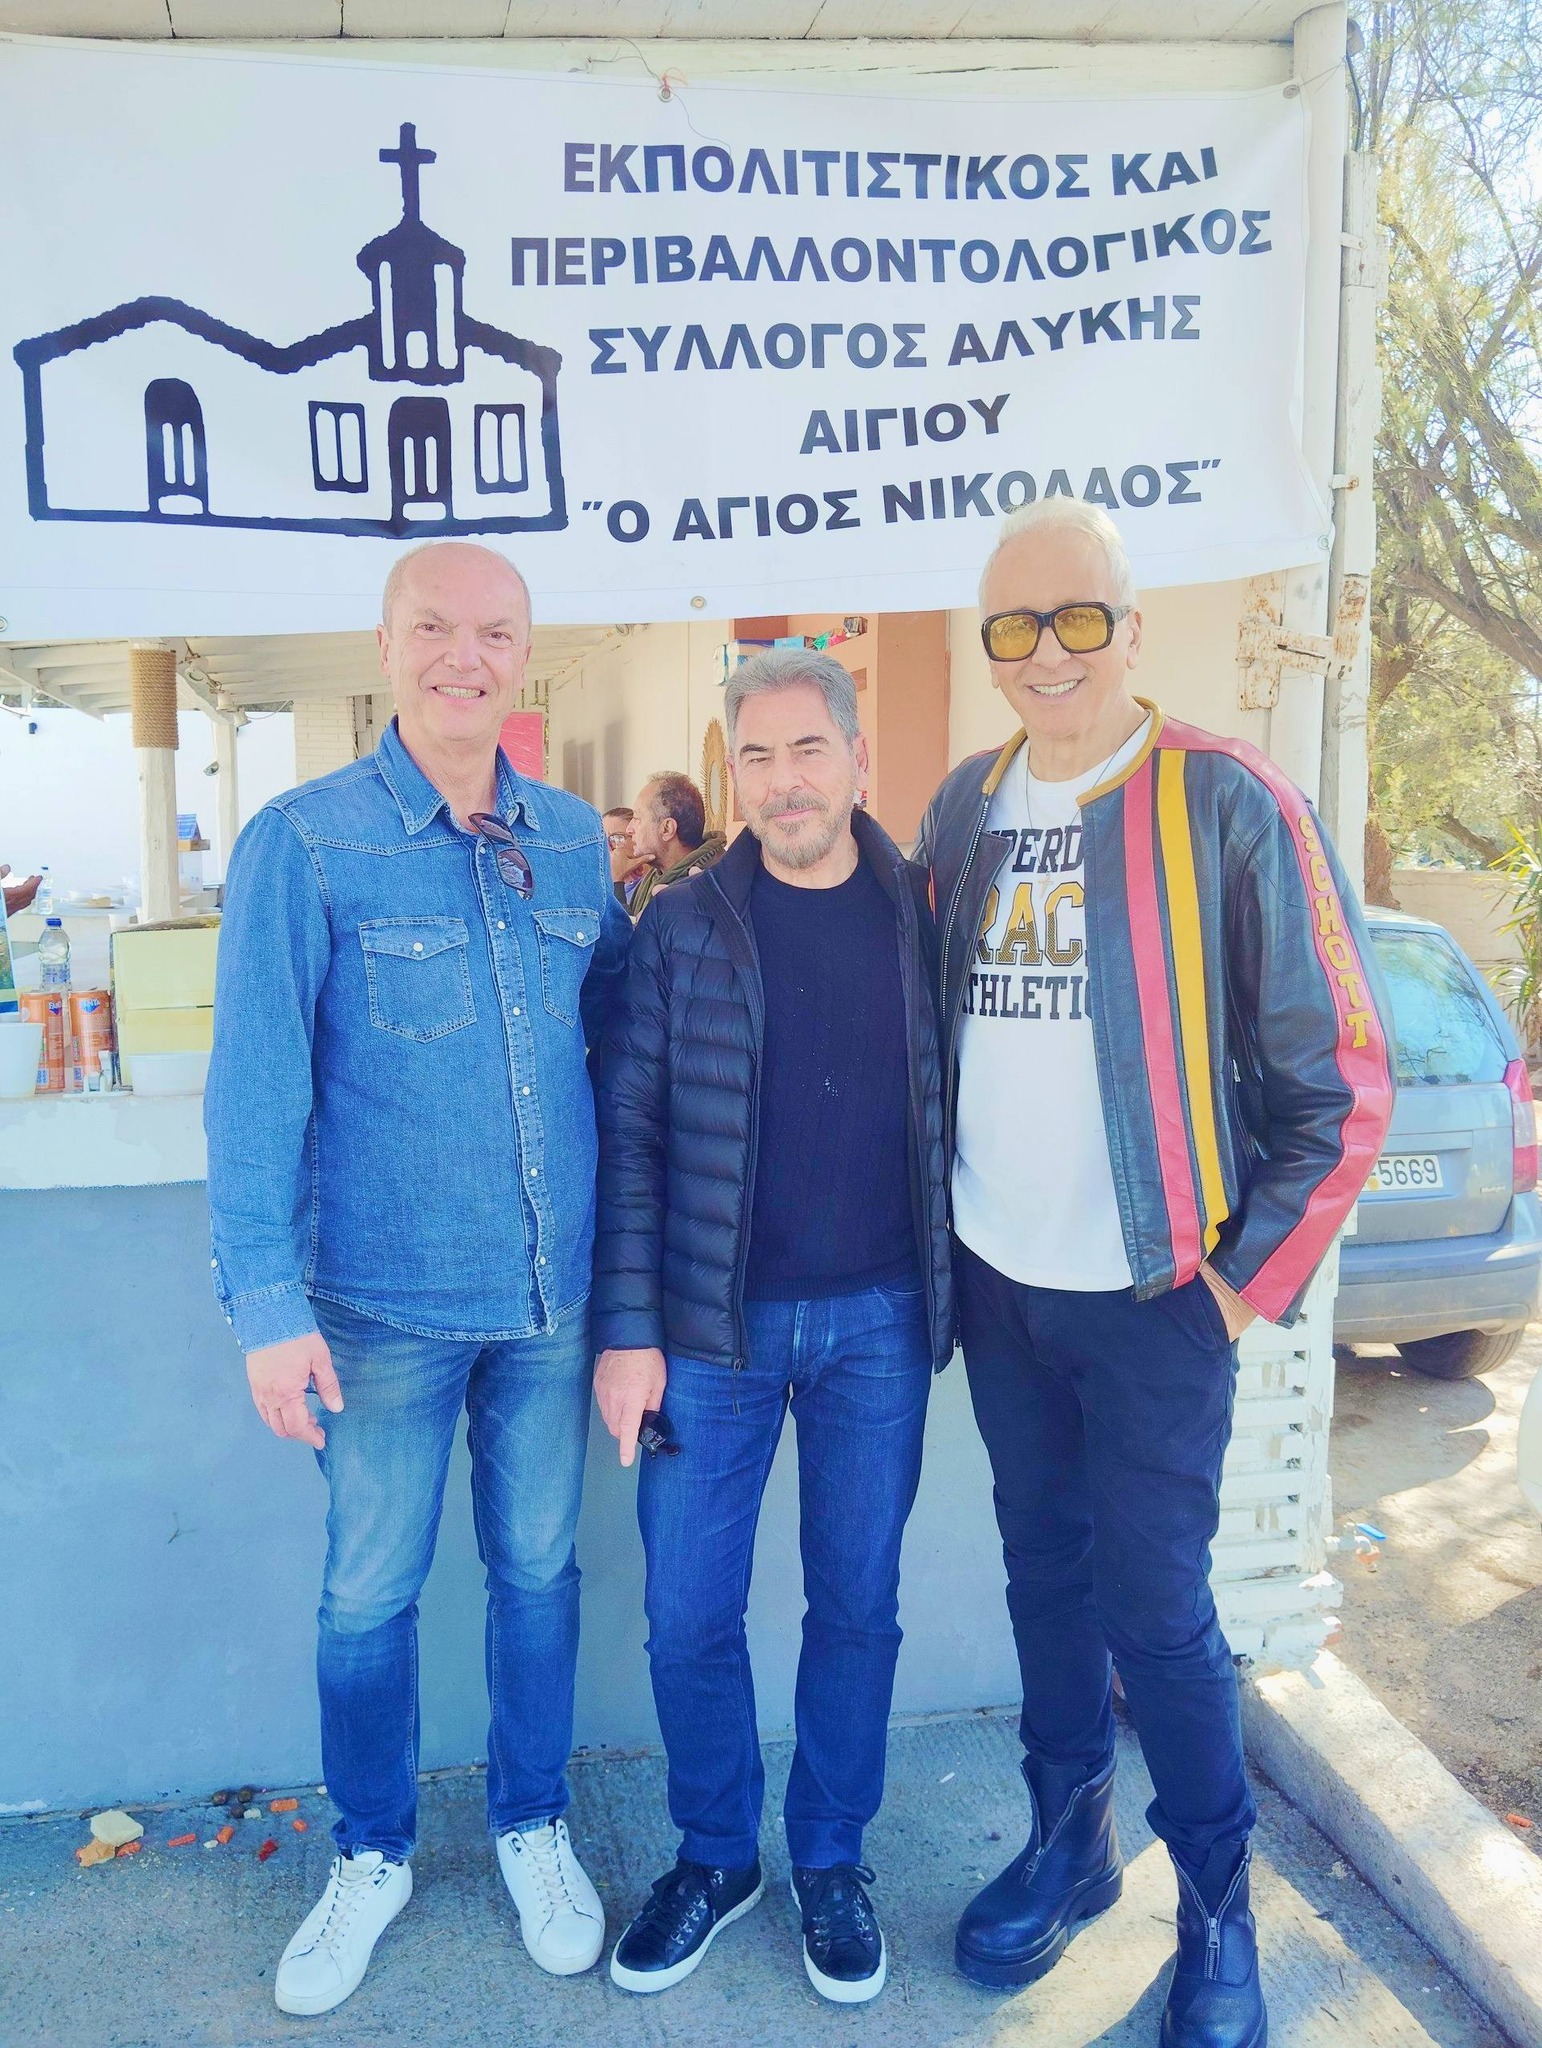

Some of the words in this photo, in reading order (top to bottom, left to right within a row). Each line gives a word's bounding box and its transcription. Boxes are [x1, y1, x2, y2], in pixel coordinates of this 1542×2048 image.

[563, 143, 1089, 200] ΕΚΠΟΛΙΤΙΣΤΙΚΟΣ
[1111, 146, 1219, 196] ΚΑΙ
[511, 209, 1272, 286] ΠΕΡΙΒΑΛΛΟΝΤΟΛΟΓΙΚΟΣ
[589, 323, 927, 374] ΣΥΛΛΟΓΟΣ
[947, 295, 1201, 366] ΑΛΥΚΗΣ
[799, 393, 1011, 454] ΑΙΓΙΟΥ
[672, 489, 862, 542] ΑΓΙΟΣ
[974, 881, 1089, 966] RAC
[1299, 815, 1371, 1049] SCHOTT
[962, 973, 1093, 1020] THLETI
